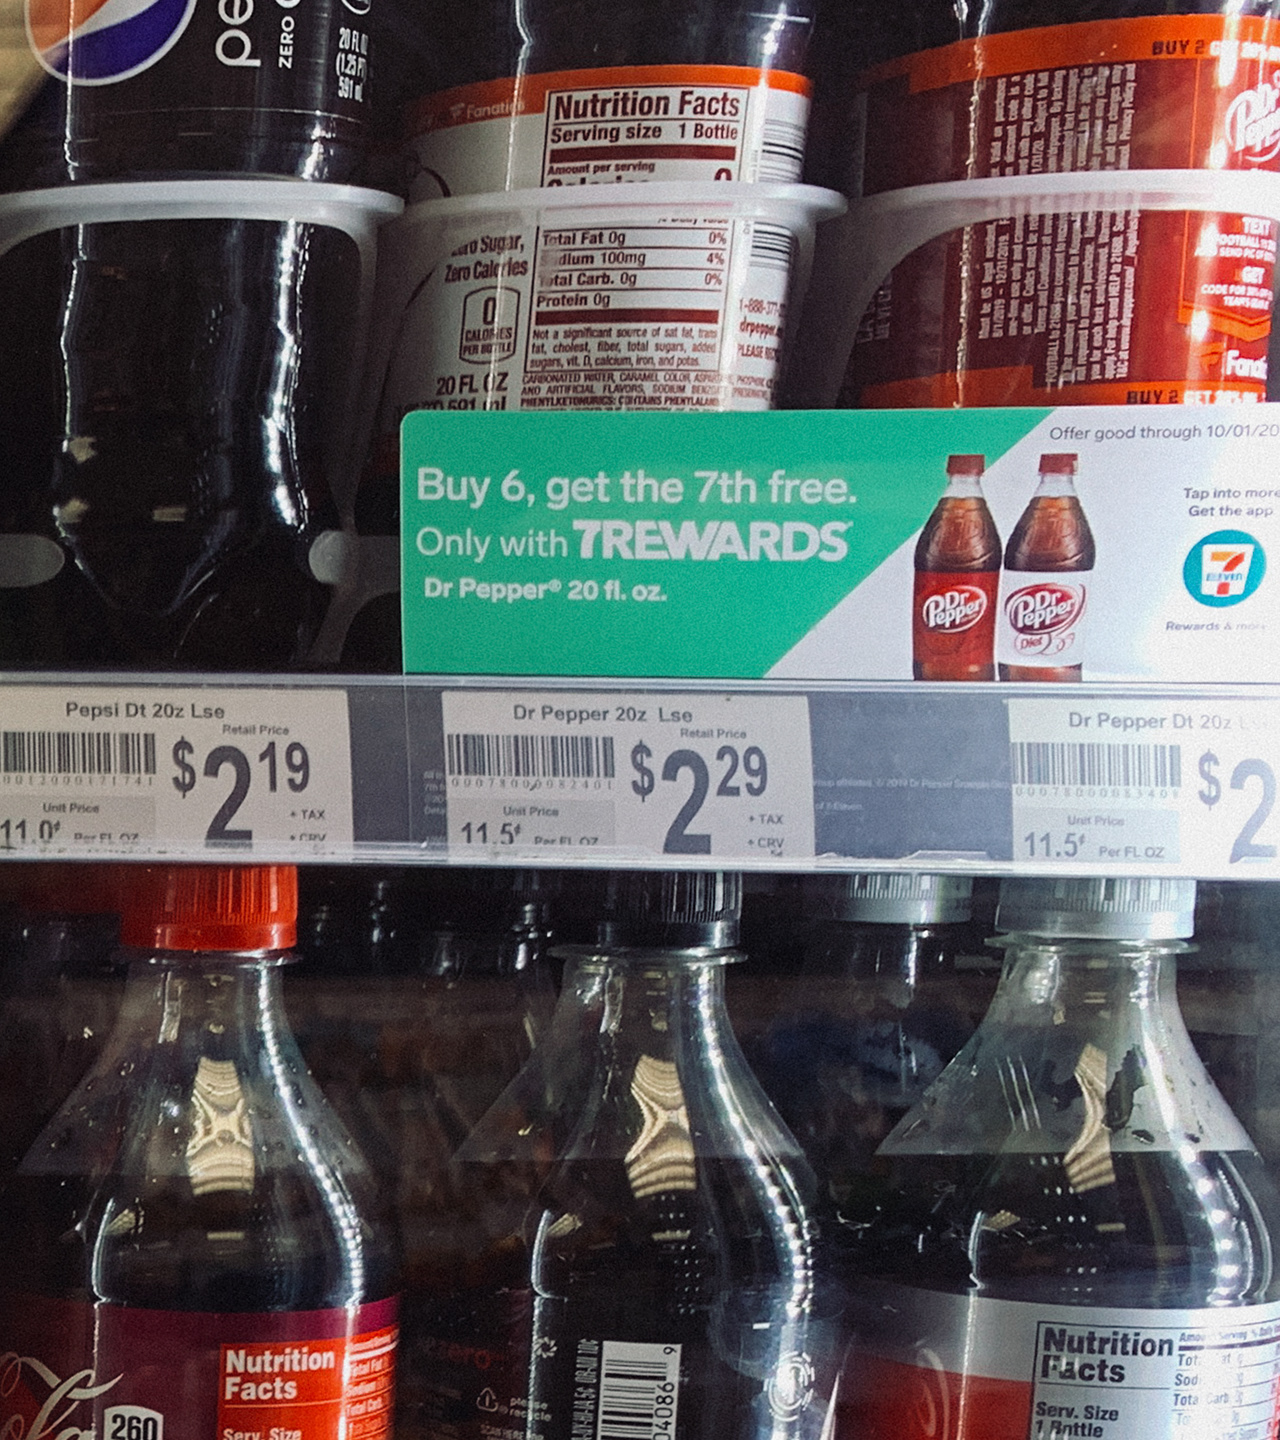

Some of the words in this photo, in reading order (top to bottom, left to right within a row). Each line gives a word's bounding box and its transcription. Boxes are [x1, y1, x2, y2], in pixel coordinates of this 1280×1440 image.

[278, 15, 295, 69] ZERO
[555, 91, 670, 118] Nutrition
[679, 91, 740, 116] Facts
[550, 124, 617, 143] Serving
[626, 124, 662, 141] size
[678, 125, 685, 139] 1
[694, 124, 737, 139] Bottle
[1050, 427, 1090, 440] Offer
[1095, 427, 1135, 442] good
[1140, 426, 1201, 442] through
[418, 467, 489, 507] Buy
[501, 470, 535, 505] 6,
[547, 470, 609, 509] get
[619, 470, 683, 502] the
[694, 471, 756, 504] 7th
[769, 471, 857, 504] free.
[1184, 488, 1210, 500] Tap
[1214, 488, 1241, 498] into
[1189, 506, 1215, 517] Get
[1219, 506, 1242, 516] the
[1246, 507, 1273, 518] app
[416, 527, 489, 562] Only
[500, 528, 567, 557] with
[424, 578, 453, 598] Dr
[568, 580, 598, 599] 20
[605, 581, 627, 600] fl.
[632, 585, 667, 601] oz.
[66, 702, 121, 721] Pepsi
[126, 702, 147, 717] Dt
[191, 704, 224, 719] Lse
[513, 704, 534, 722] Dr
[540, 706, 608, 726] Pepper
[659, 708, 692, 723] Lse
[1042, 1328, 1174, 1358] Nutrition
[226, 1348, 335, 1376] Nutrition
[1042, 1355, 1125, 1382] Facts
[224, 1376, 298, 1400] Facts
[111, 1416, 159, 1440] 260
